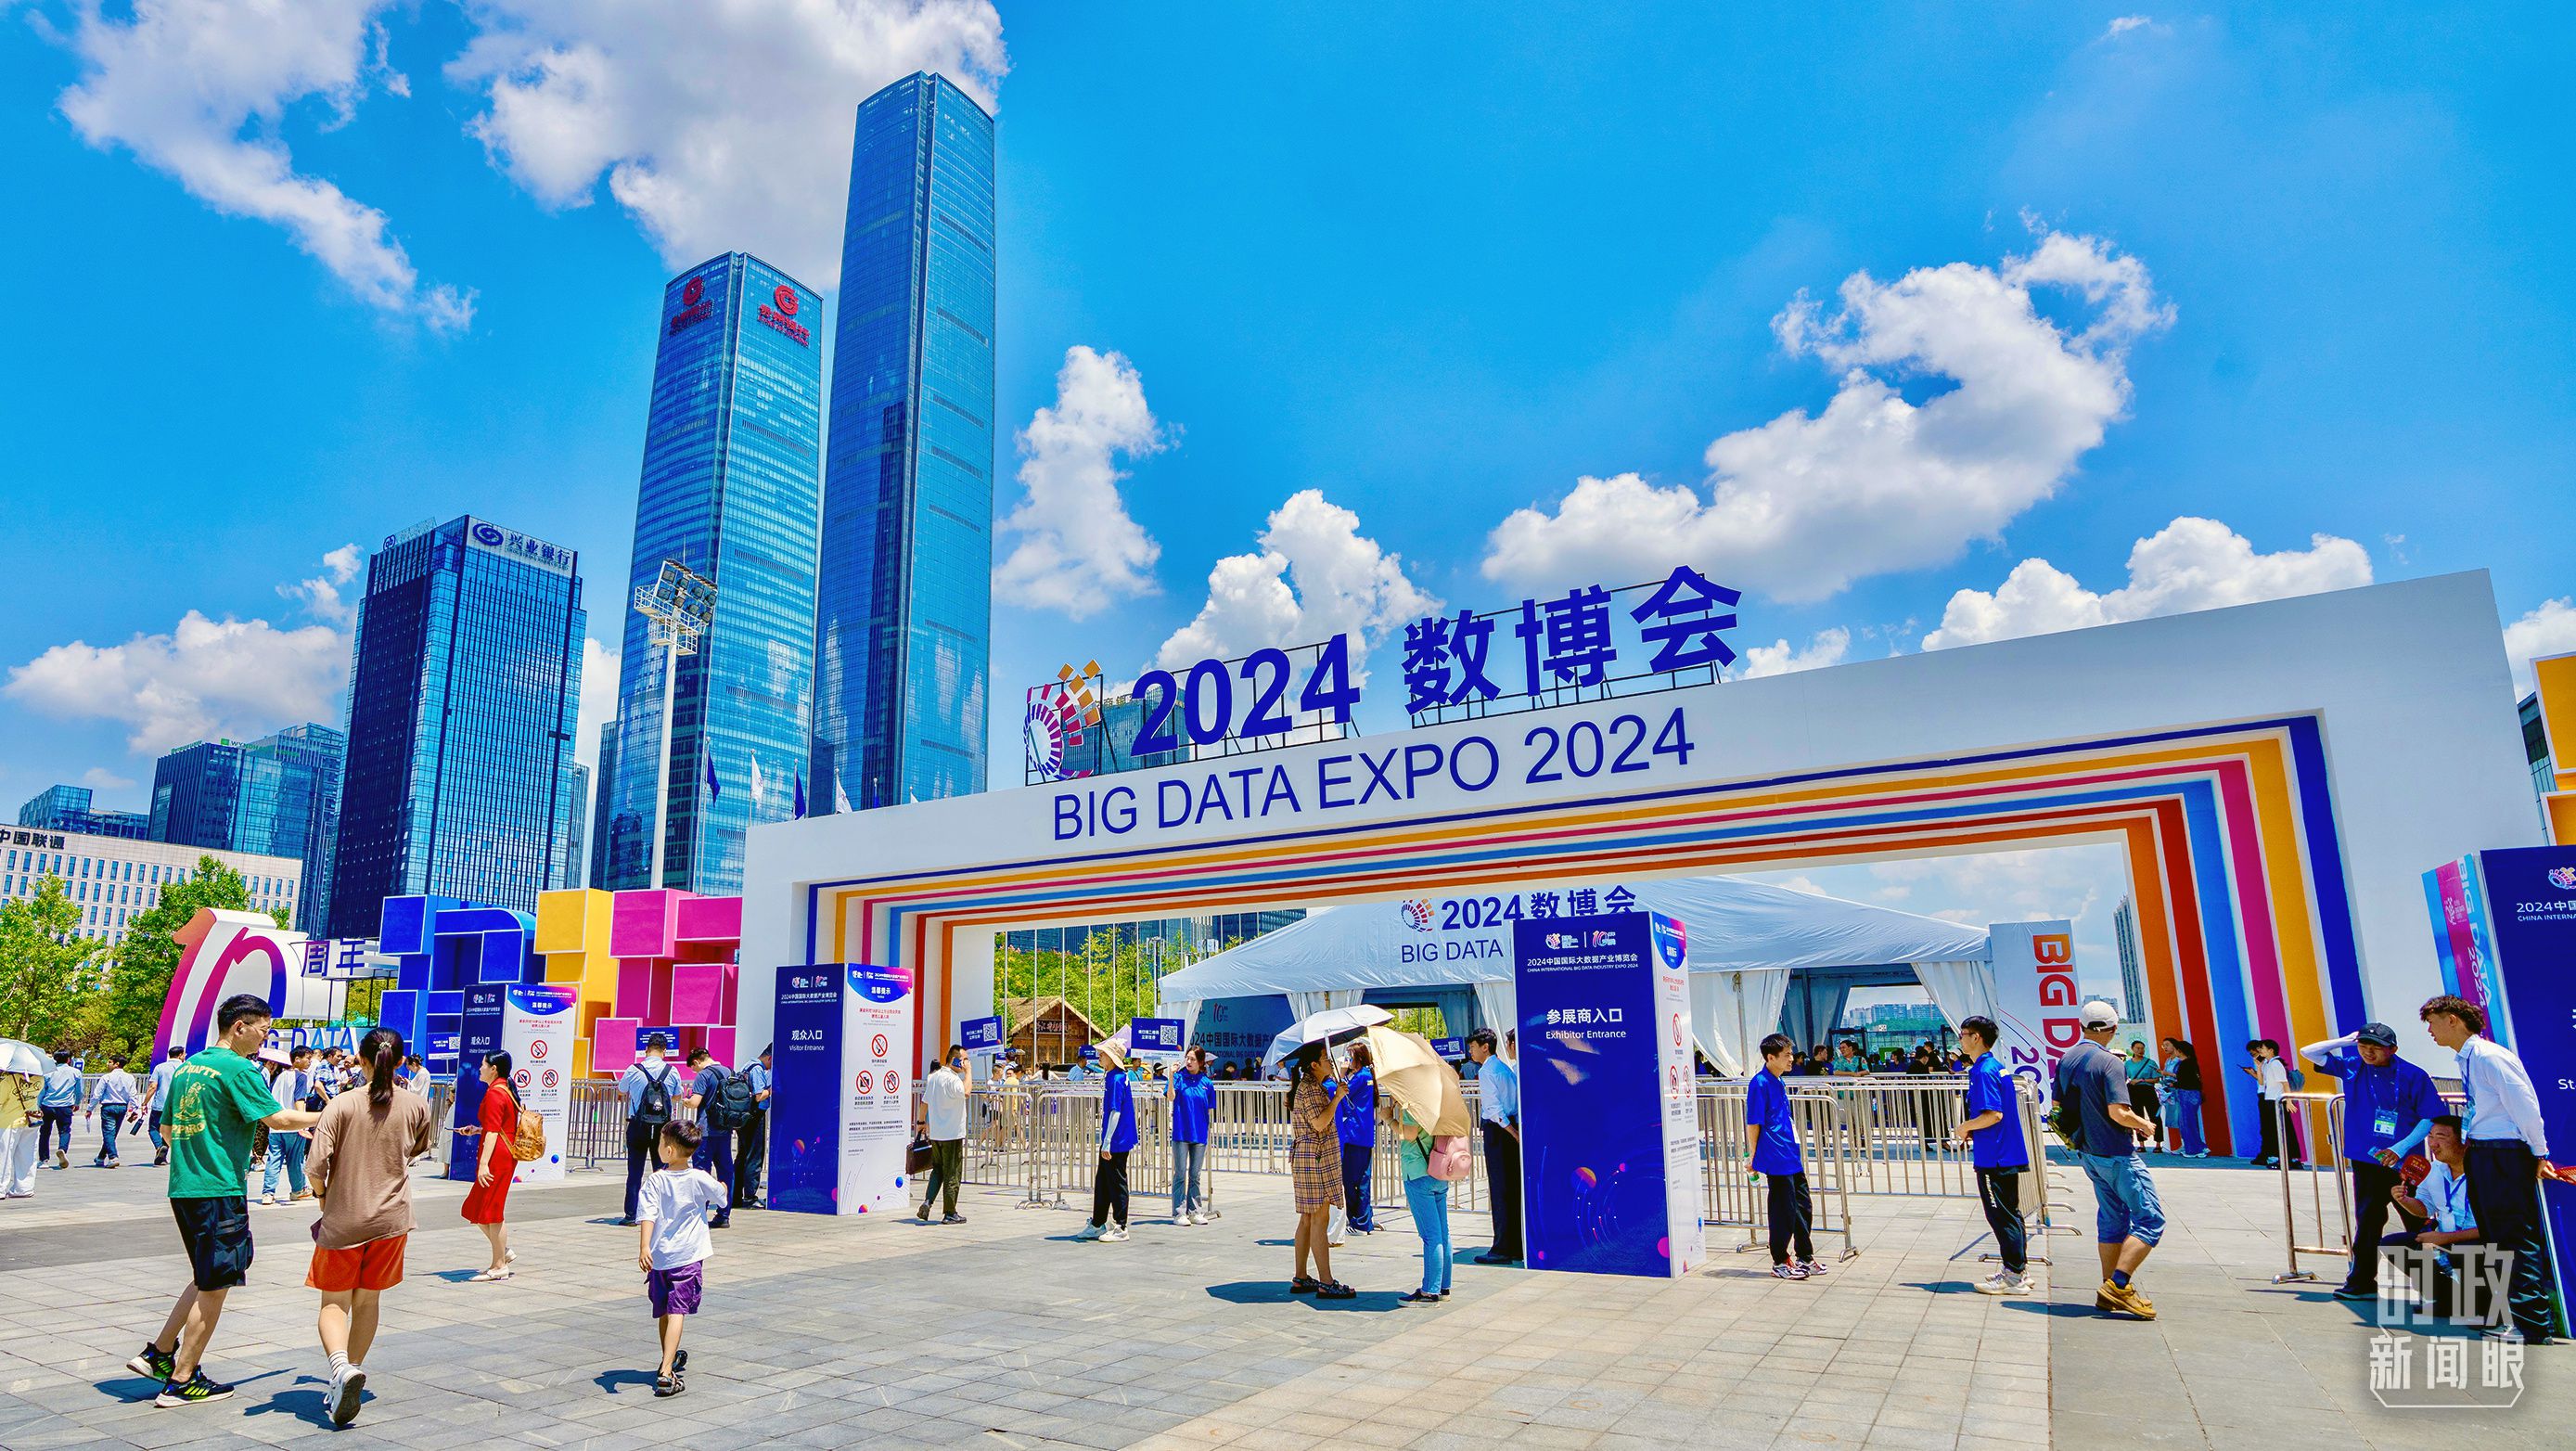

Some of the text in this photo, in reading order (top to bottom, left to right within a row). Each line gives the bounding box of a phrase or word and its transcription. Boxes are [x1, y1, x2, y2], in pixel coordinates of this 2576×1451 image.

[508, 533, 570, 566] 兴业银行
[1131, 566, 1741, 756] 2024 数博会
[1055, 708, 1695, 841] BIG DATA EXPO 2024
[0, 828, 65, 850] 中国联通
[2457, 858, 2475, 914] BIG
[1442, 885, 1636, 931] 2024 数博会
[301, 938, 366, 977] 周年
[1402, 938, 1504, 963] BIG DATA
[1527, 953, 1638, 967] 2024中国国际大数据产业博览会
[2469, 922, 2493, 1008] DATA
[2032, 933, 2078, 1006] BIG
[2467, 946, 2486, 1008] 2024
[1546, 1008, 1622, 1025] 参展商入口
[291, 1027, 354, 1056] DATA
[791, 1029, 823, 1041] 观众入口
[1546, 1030, 1627, 1040] Exhibitor Entrance
[2557, 1079, 2576, 1090] St
